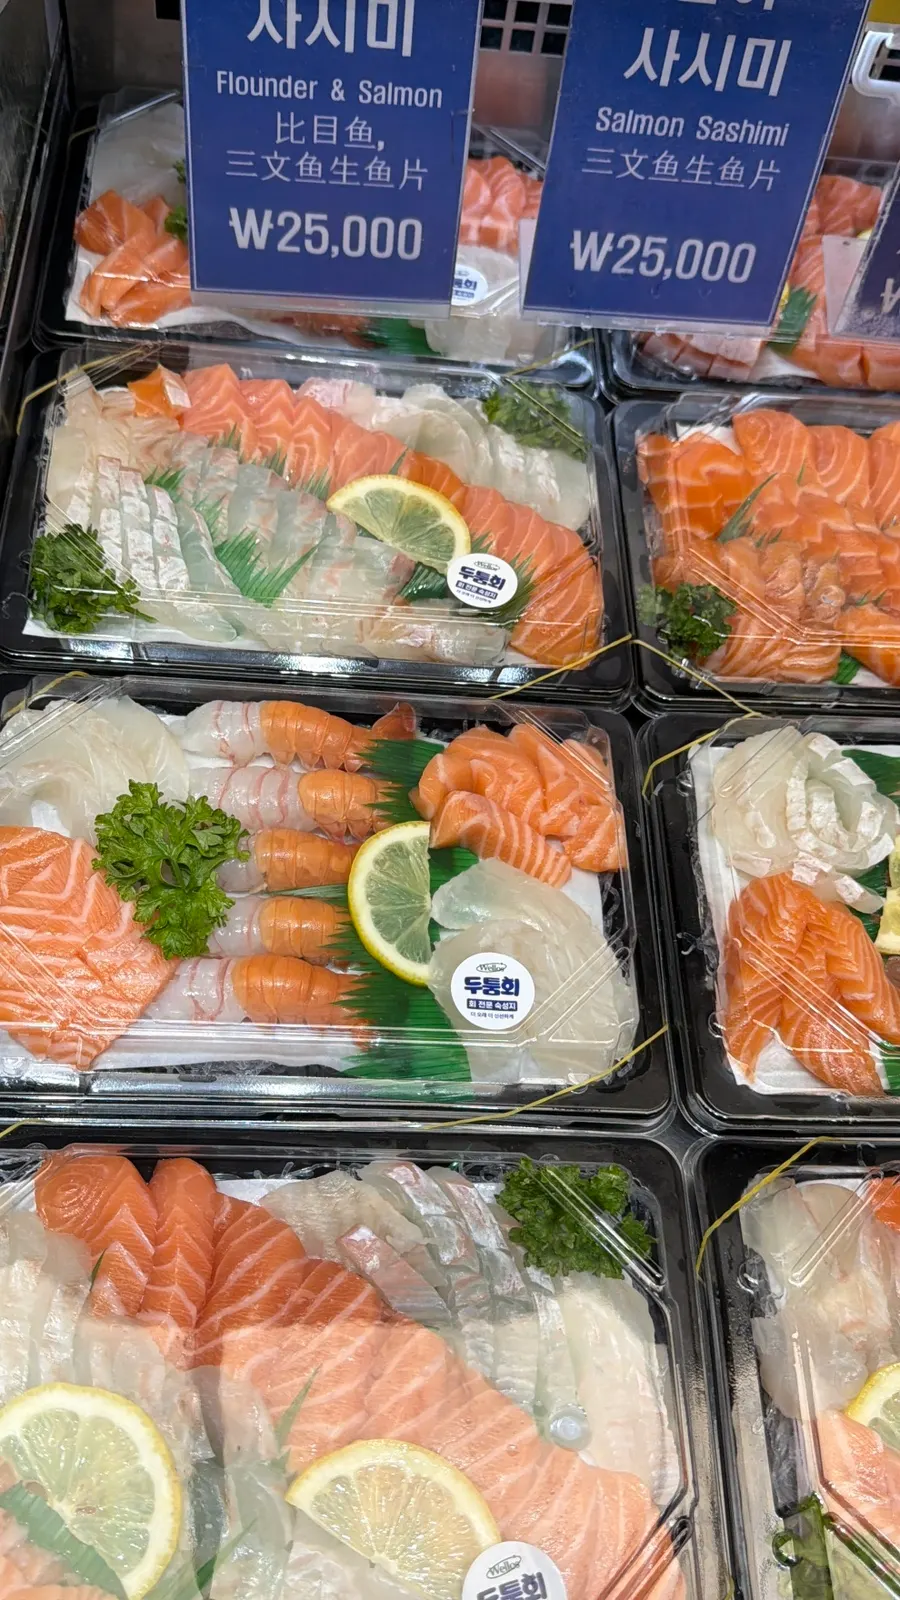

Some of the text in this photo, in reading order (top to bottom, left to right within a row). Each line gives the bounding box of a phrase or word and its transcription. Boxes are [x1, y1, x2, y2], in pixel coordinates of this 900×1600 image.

[247, 0, 415, 57] 사시미
[623, 27, 792, 97] 사시미
[216, 70, 443, 108] Flounder & Salmon
[275, 111, 385, 152] 比目鱼,
[595, 106, 790, 147] Salmon Sashimi
[225, 150, 428, 192] 三文鱼生鱼片
[581, 147, 781, 192] 三文鱼生鱼片
[229, 206, 424, 261] ₩25,000
[569, 229, 757, 284] ₩25,000
[464, 976, 520, 997] 두툼회
